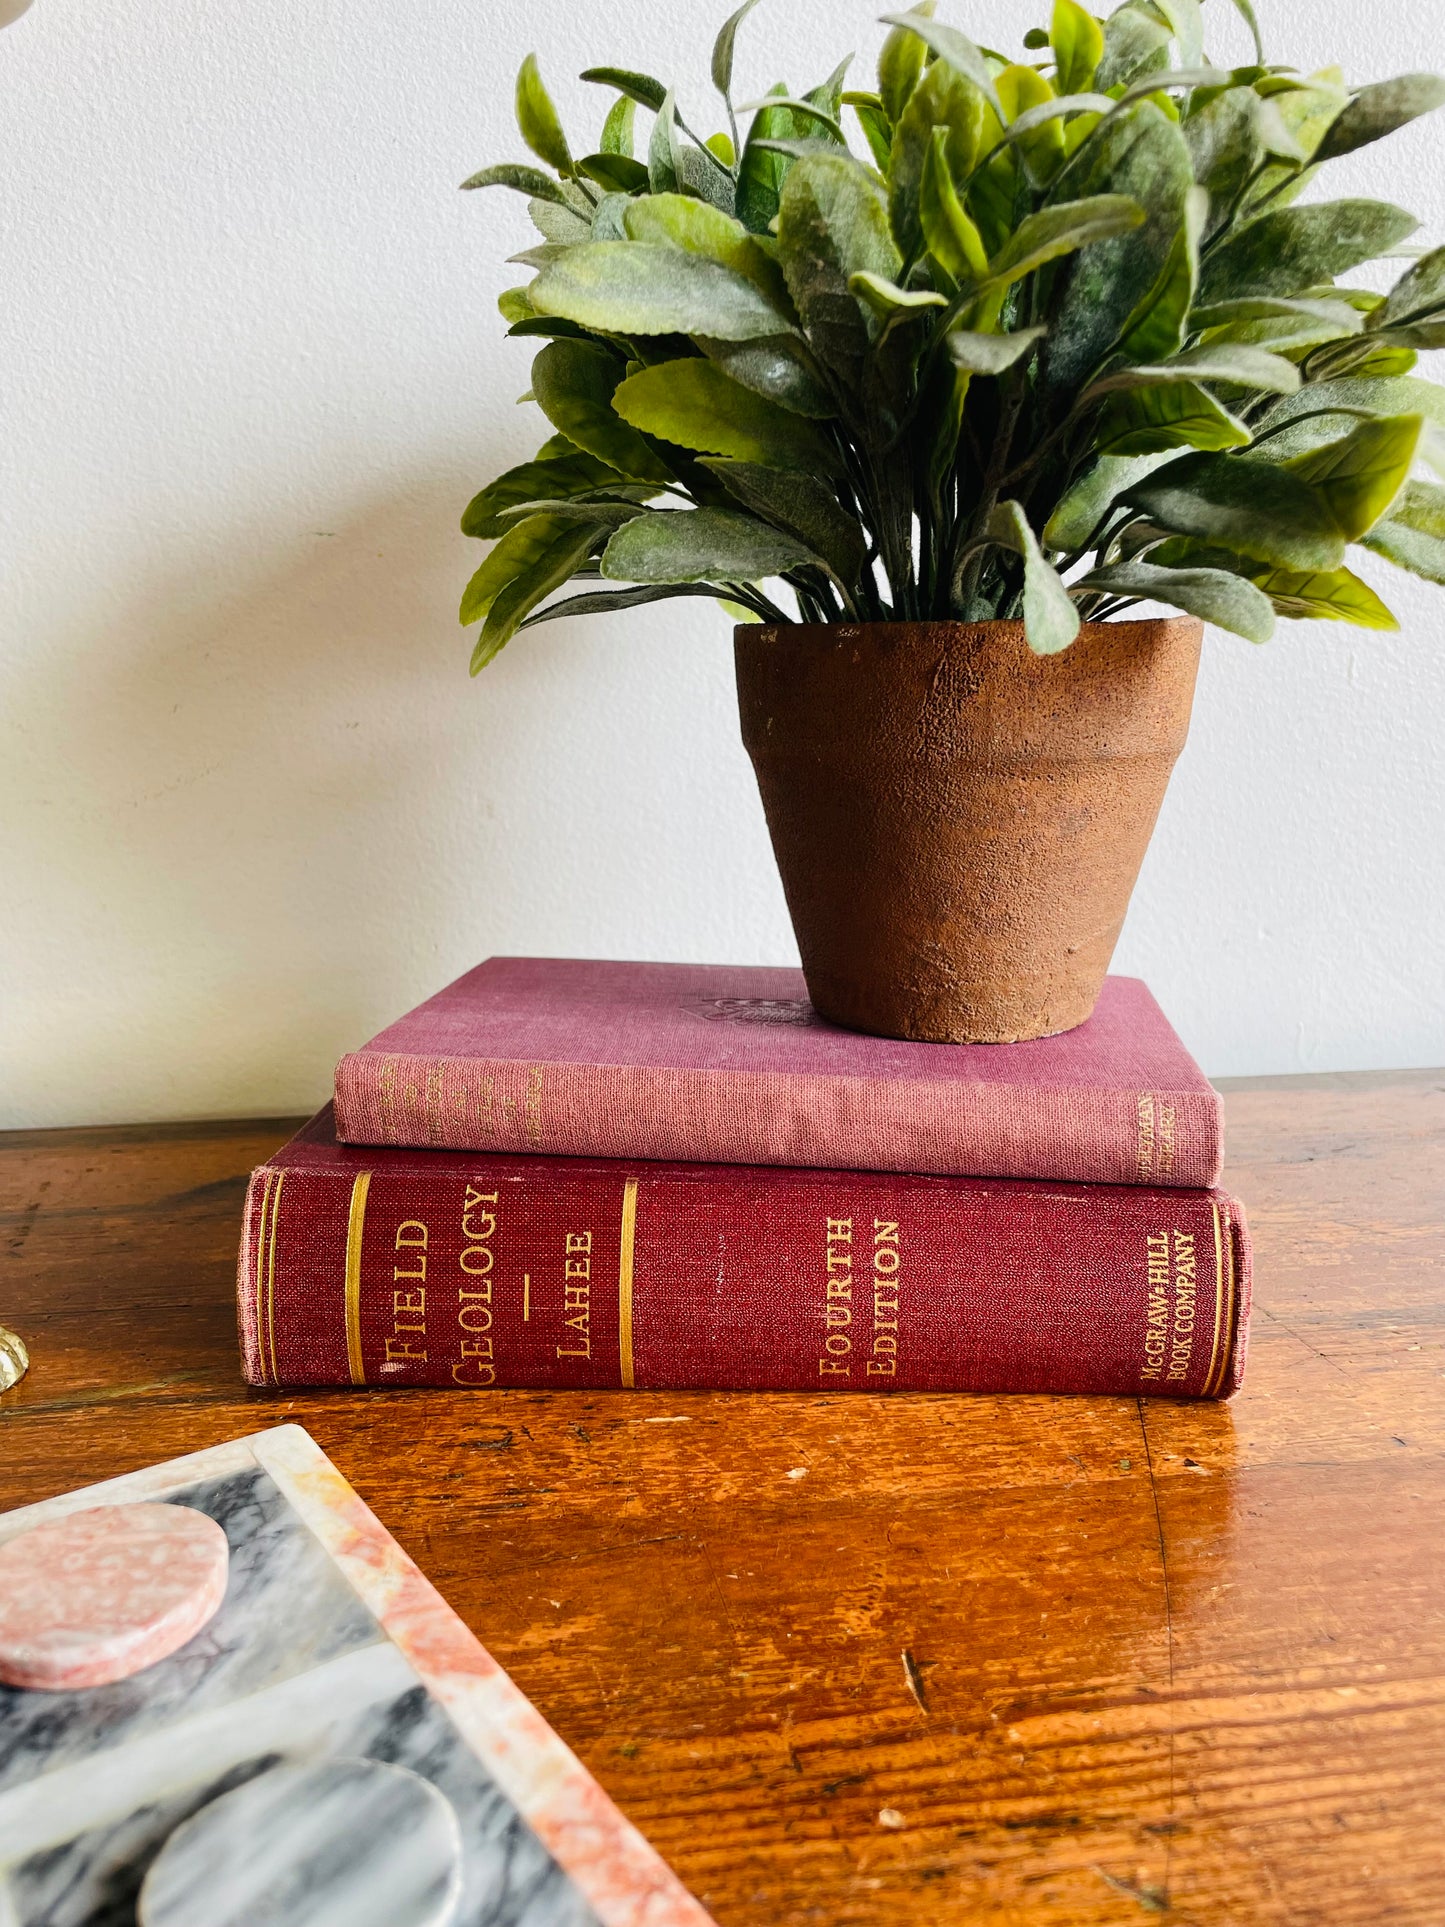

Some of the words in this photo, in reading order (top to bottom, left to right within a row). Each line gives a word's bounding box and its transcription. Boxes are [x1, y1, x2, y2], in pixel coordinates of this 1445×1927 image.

[385, 1219, 429, 1362] FIELD
[452, 1184, 498, 1386] GEOLOGY
[556, 1231, 592, 1359] LAHEE
[819, 1216, 852, 1376] FOURTH
[866, 1218, 899, 1376] EDITION
[1174, 1229, 1196, 1333] COMPANY
[1166, 1337, 1193, 1381] BOOK
